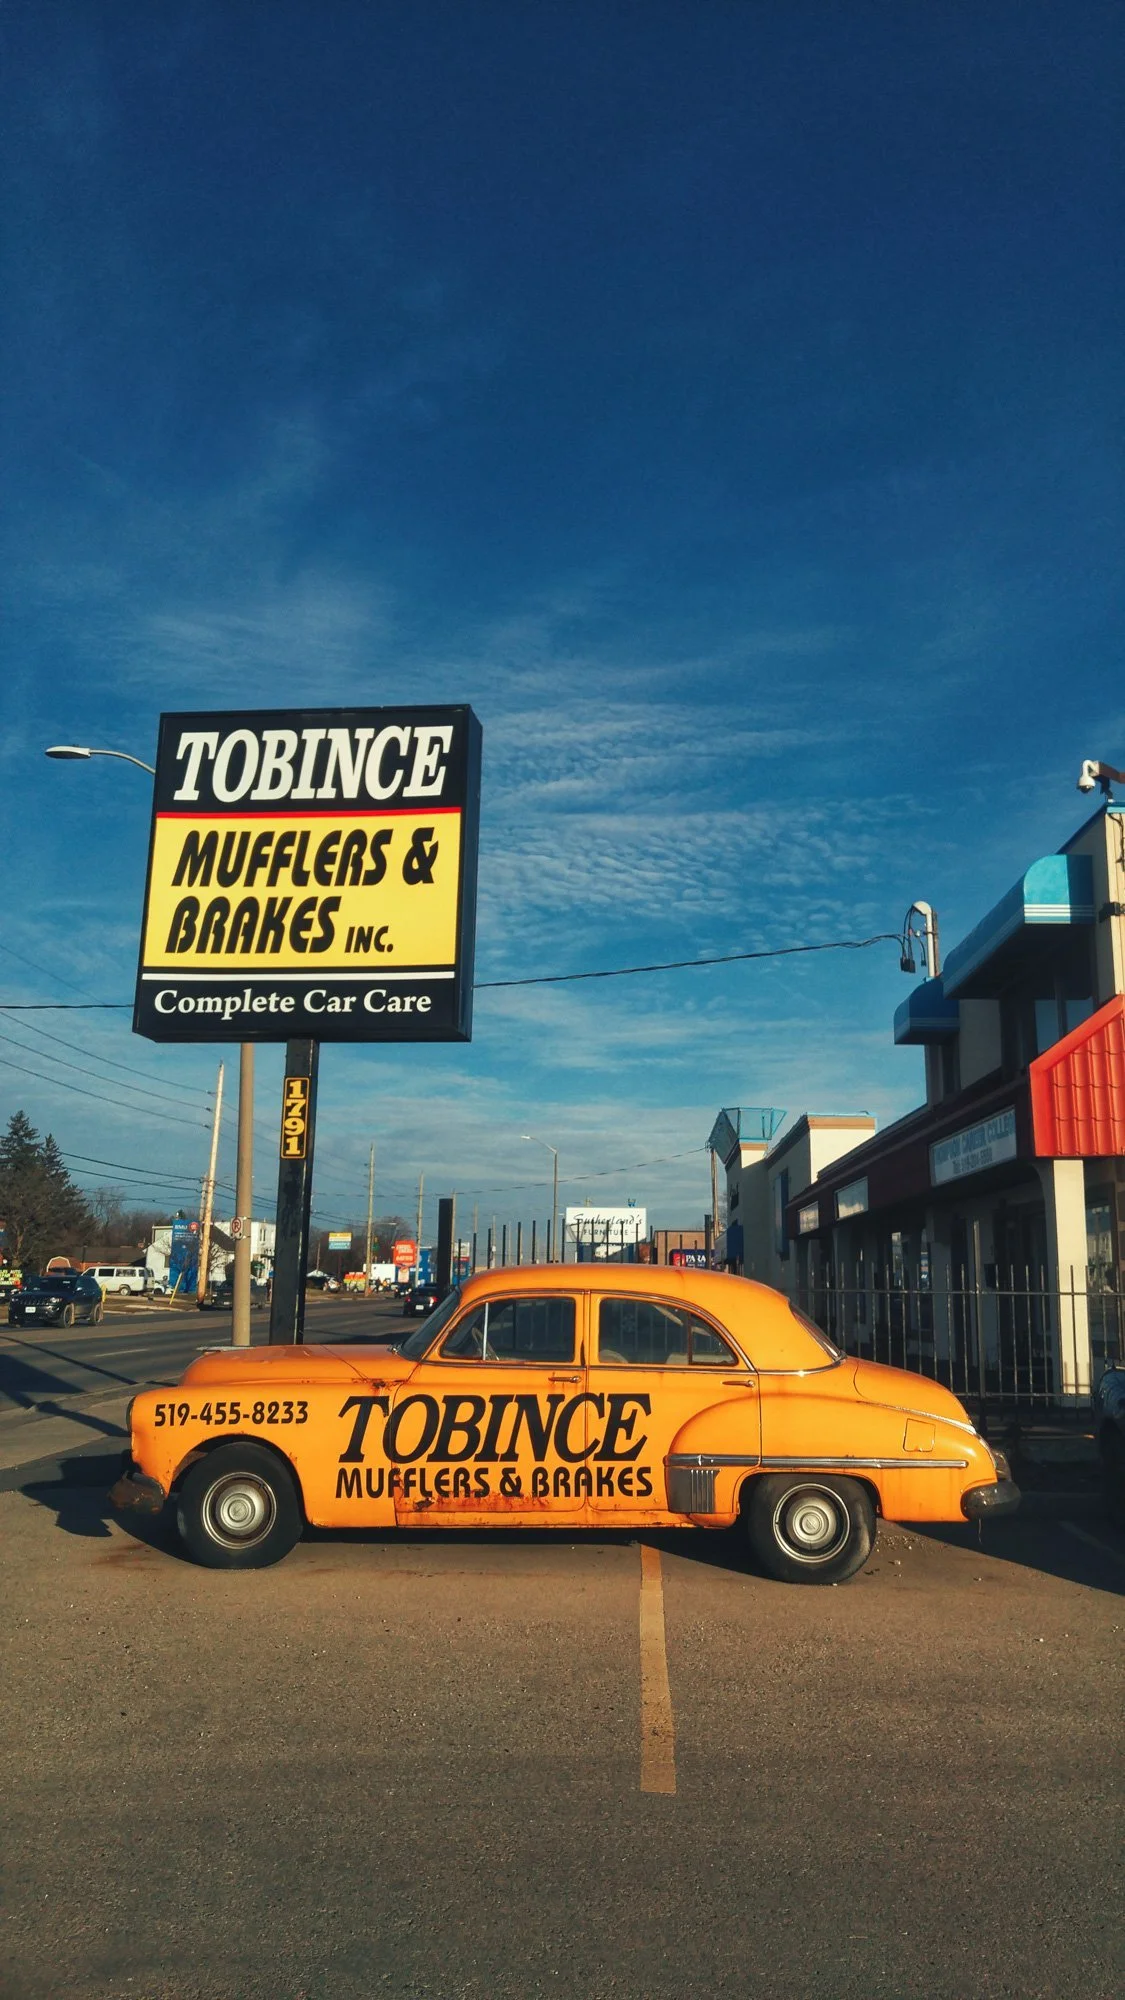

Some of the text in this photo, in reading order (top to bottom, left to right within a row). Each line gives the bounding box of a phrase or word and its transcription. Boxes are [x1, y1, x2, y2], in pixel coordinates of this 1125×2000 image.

[174, 726, 453, 803] TOBINCE
[172, 827, 439, 888] MUFFLERS &
[165, 896, 394, 954] BRAKES INC.
[154, 989, 432, 1020] Complete Car Care
[284, 1080, 306, 1155] 1791
[154, 1401, 308, 1427] 519-455-8233
[338, 1393, 651, 1463] TOBINCE
[335, 1466, 653, 1499] MUFFLERS & BRAKES
